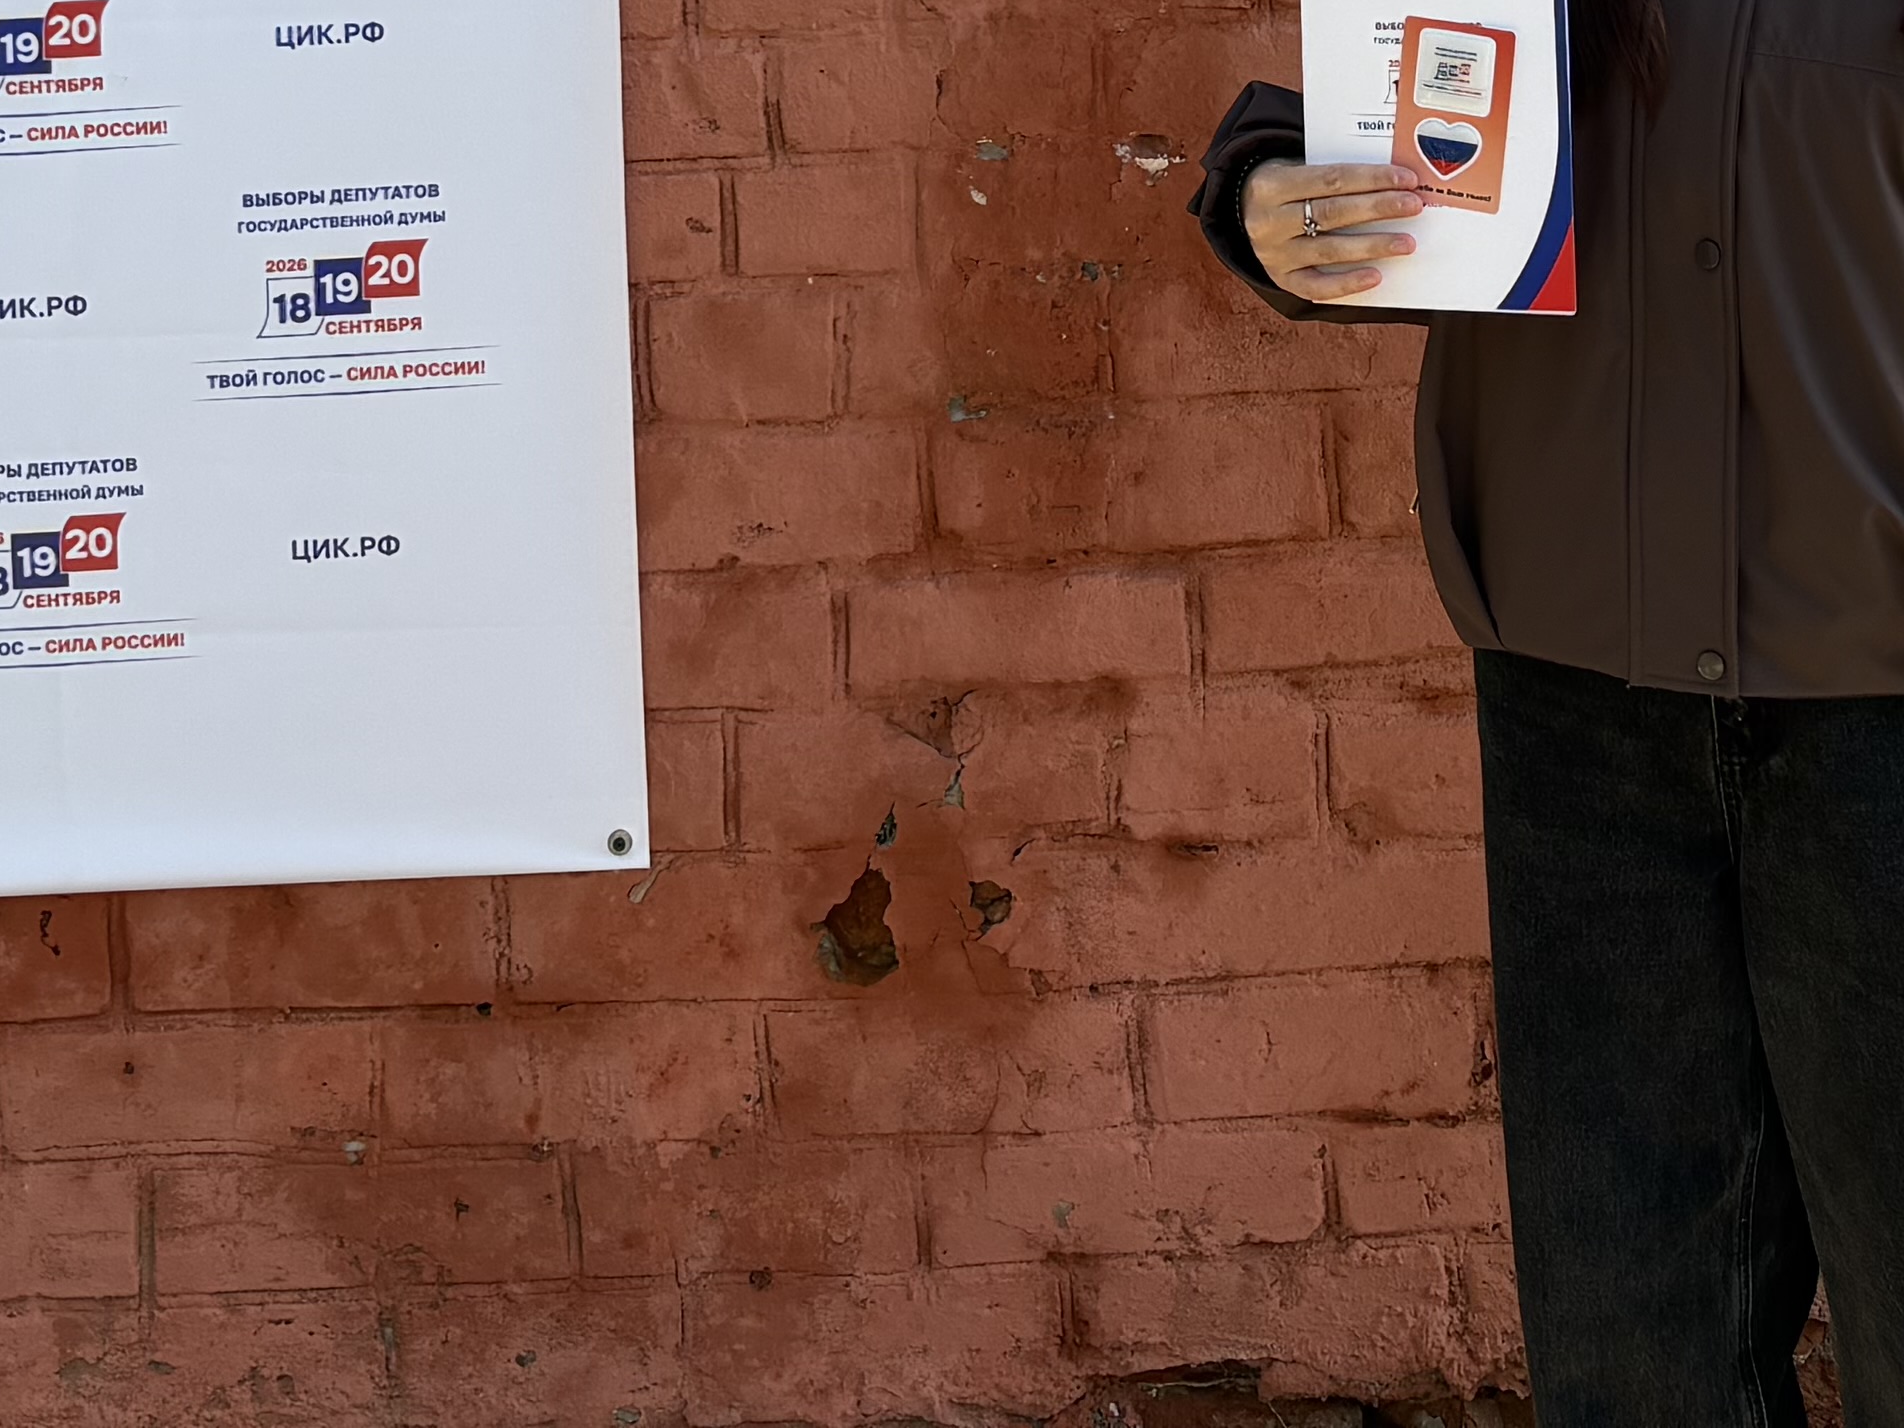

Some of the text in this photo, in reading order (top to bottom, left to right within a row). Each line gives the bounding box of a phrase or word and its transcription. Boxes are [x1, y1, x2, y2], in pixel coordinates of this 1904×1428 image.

[0, 31, 40, 64] 19
[48, 13, 97, 46] 20
[275, 21, 385, 50] ЦИК.РФ
[5, 76, 104, 96] СЕНТЯБРЯ
[26, 125, 80, 142] СИЛА
[83, 120, 168, 139] РОССИИ!
[242, 183, 440, 208] ВЫБОРЫ ДЕПУТАТОВ
[237, 210, 446, 234] ГОСУДАРСТВЕННОЙ ДУМЫ
[265, 257, 308, 273] 2026
[272, 253, 415, 324] 18 19 20
[325, 316, 422, 336] СЕНТЯБРЯ
[206, 369, 258, 389] ТВОЙ
[262, 368, 325, 386] ГОЛОС
[346, 365, 399, 382] СИЛА
[402, 359, 485, 379] РОССИИ!
[291, 534, 401, 564] ЦИК.РФ
